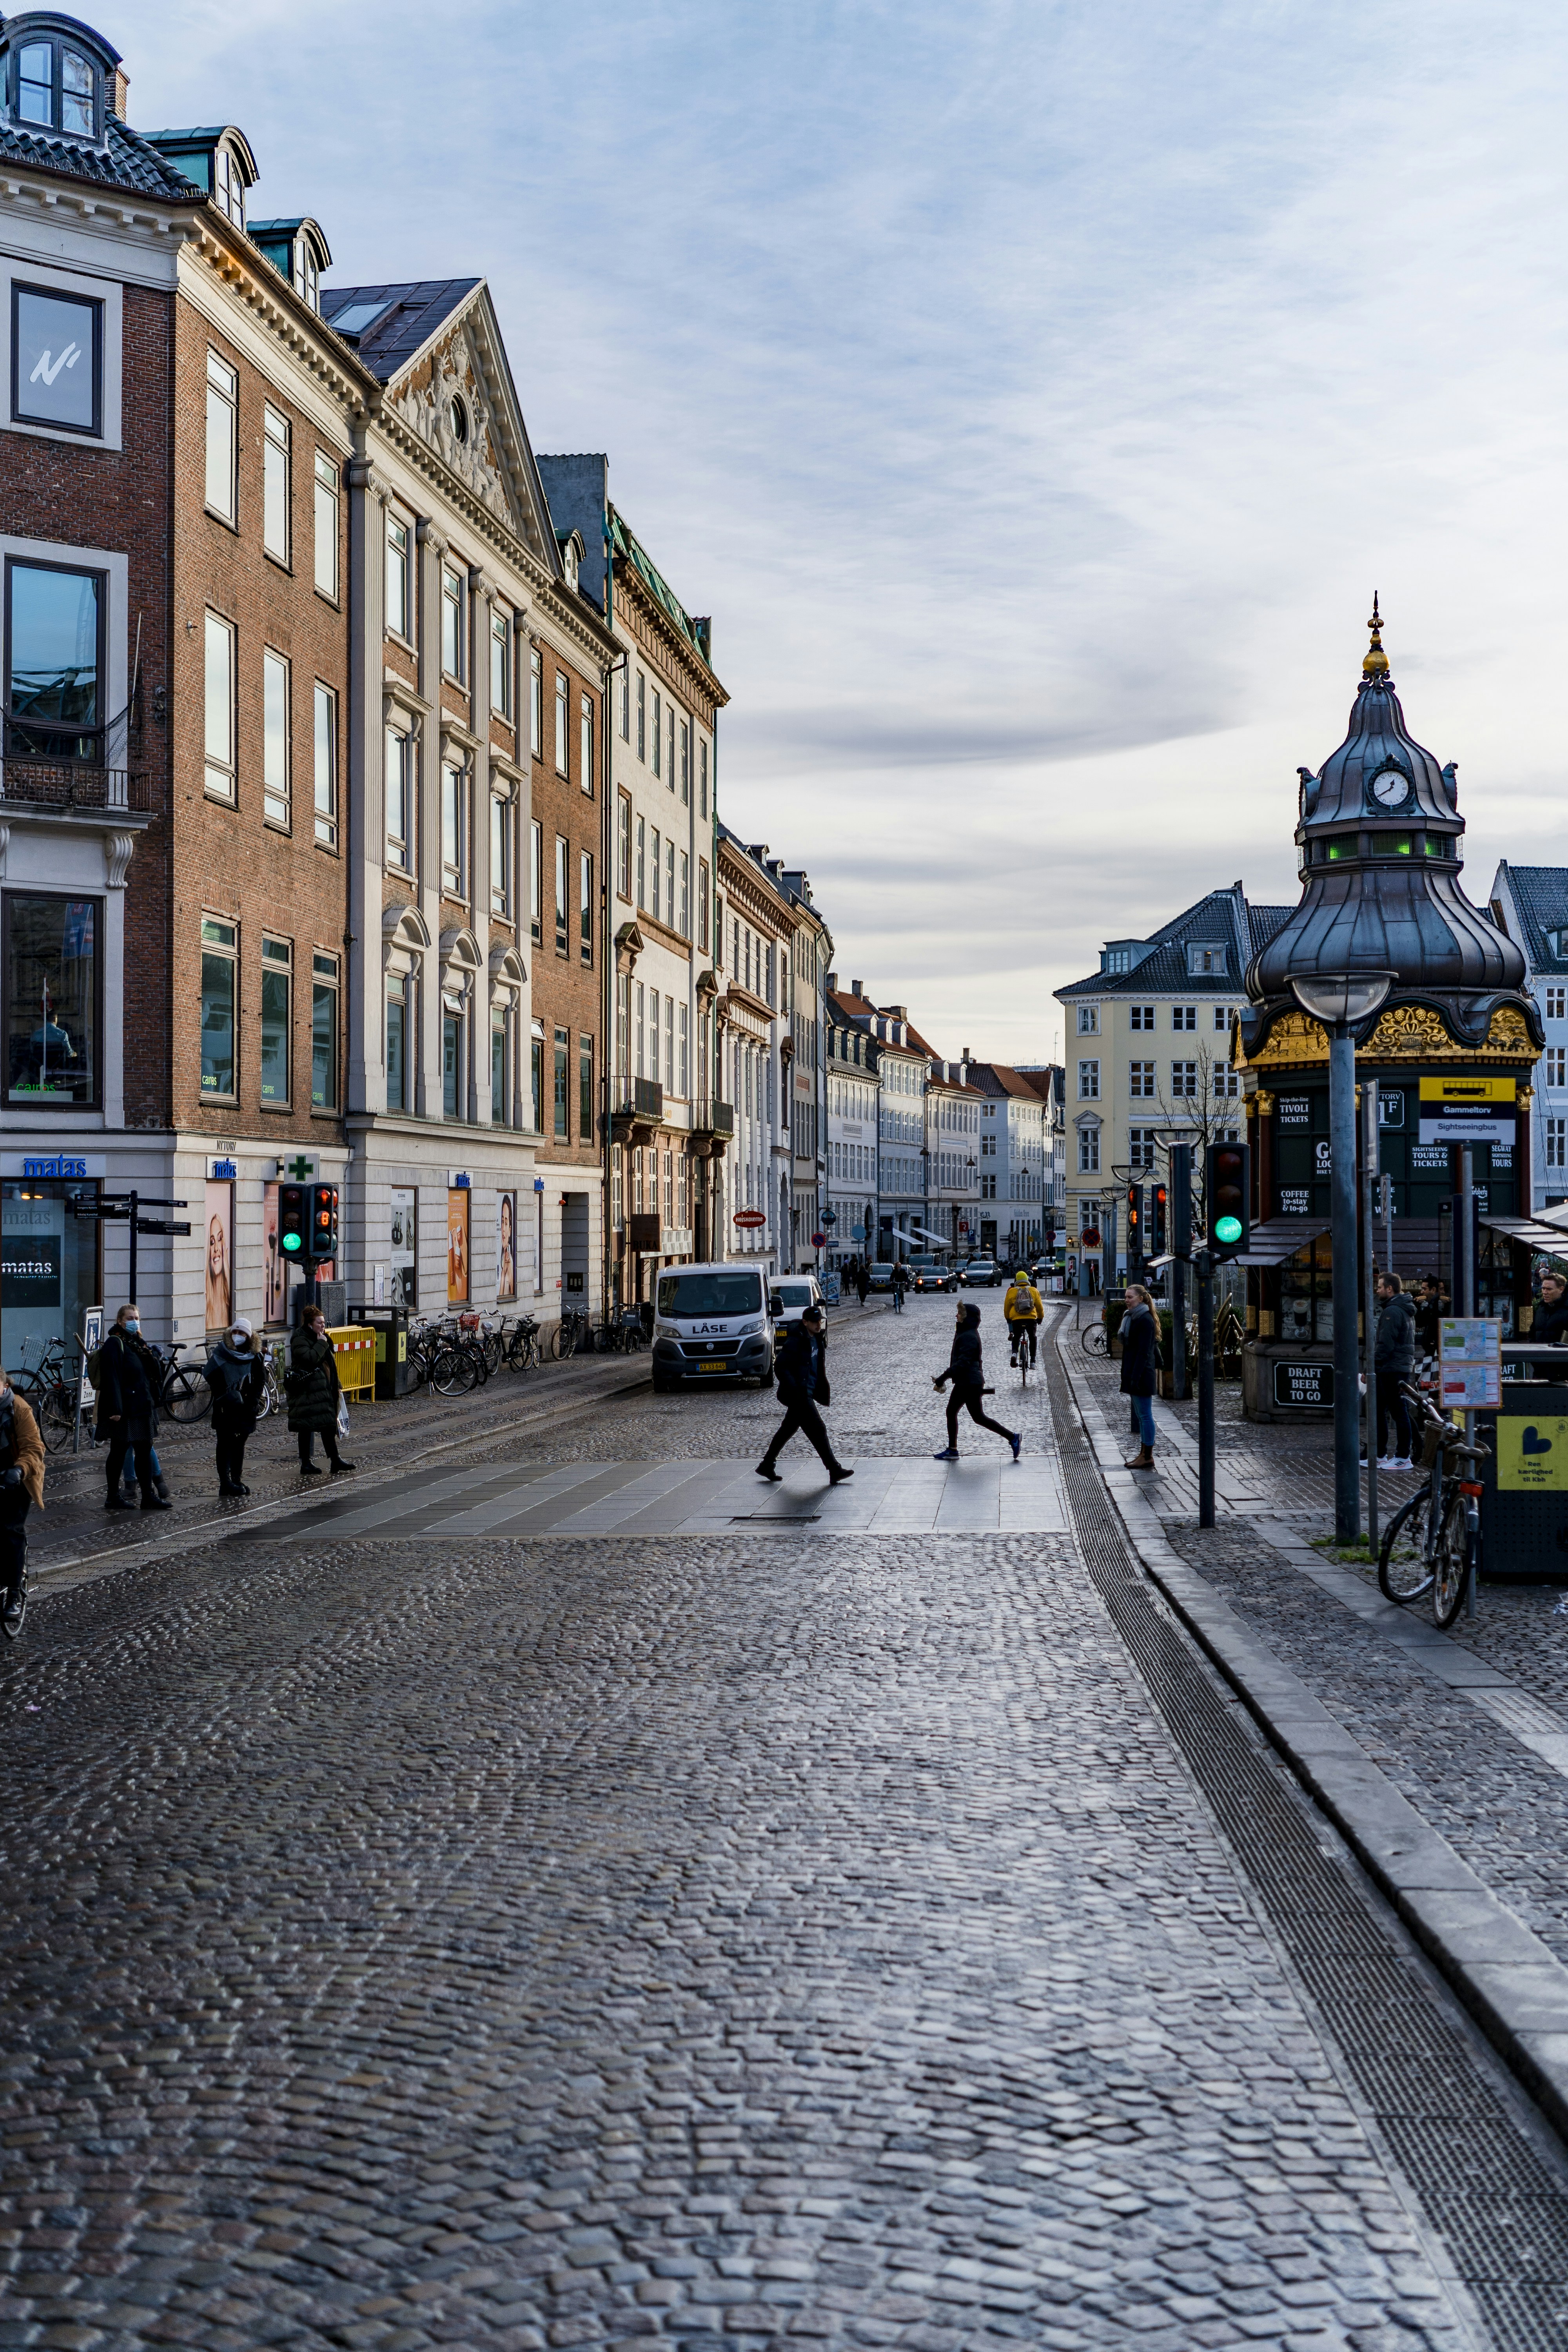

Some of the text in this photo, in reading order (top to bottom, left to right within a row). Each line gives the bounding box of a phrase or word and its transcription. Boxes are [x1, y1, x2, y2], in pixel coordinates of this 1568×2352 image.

[202, 1075, 217, 1085] cairos
[16, 1083, 55, 1093] cairos
[262, 1085, 274, 1094] cairos
[313, 1092, 323, 1100] cairos
[1279, 1104, 1308, 1112] TIVOLI
[217, 1140, 236, 1151] NYTORV
[23, 1154, 87, 1177] matas
[214, 1158, 237, 1178] matas
[456, 1171, 470, 1187] matas
[1290, 1205, 1308, 1213] to-go
[3, 1208, 51, 1225] matas
[633, 1240, 657, 1250] BUKA
[1, 1261, 52, 1274] matas
[692, 1323, 728, 1334] LÅSE
[1289, 1368, 1322, 1377] DRAFT
[1292, 1379, 1319, 1389] BEER
[1290, 1391, 1321, 1401] TO GO
